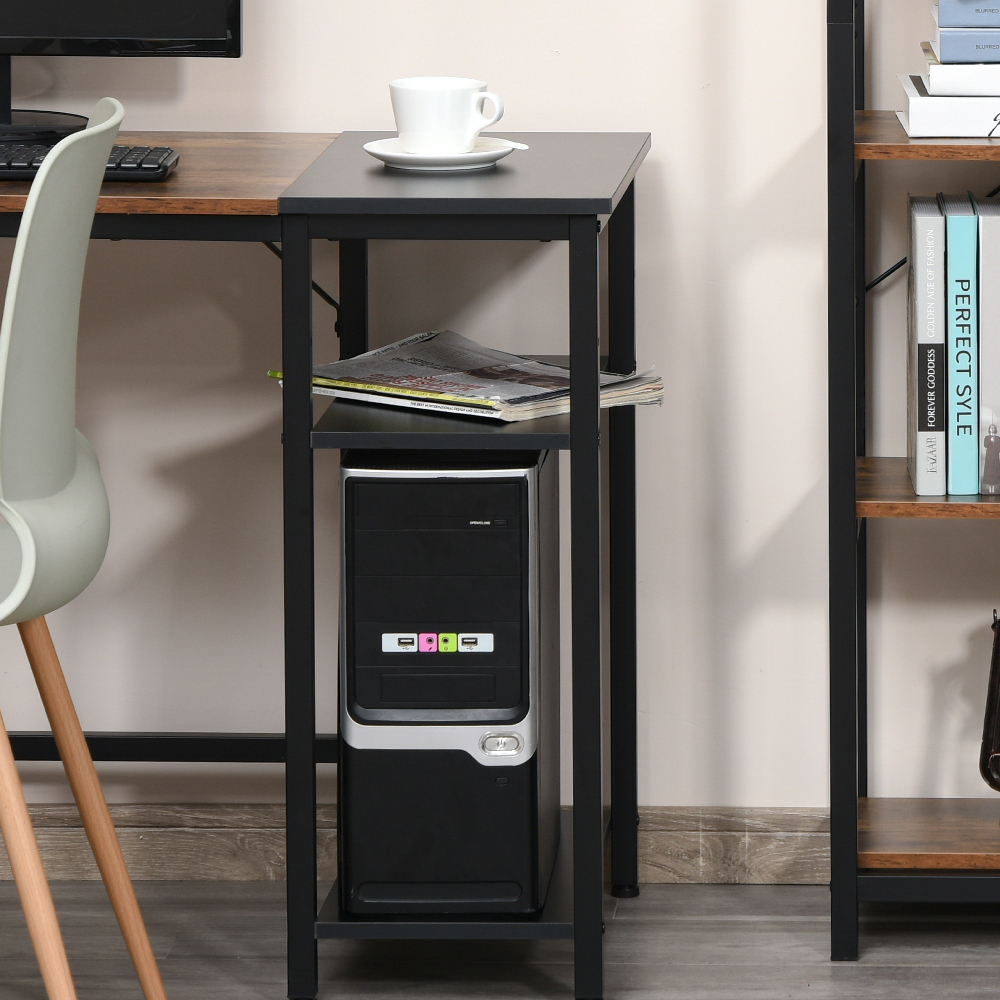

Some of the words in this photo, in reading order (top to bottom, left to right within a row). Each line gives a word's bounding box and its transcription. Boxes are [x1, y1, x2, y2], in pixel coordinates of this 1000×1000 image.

[926, 229, 935, 266] FASHION
[926, 268, 935, 281] OF
[926, 282, 935, 300] AGE
[926, 302, 935, 338] GOLDEN
[954, 279, 972, 378] PERFECT
[927, 348, 936, 389] GODDESS
[927, 391, 936, 427] FOREVER
[956, 384, 972, 436] SYLE
[926, 436, 938, 474] BAZAAR
